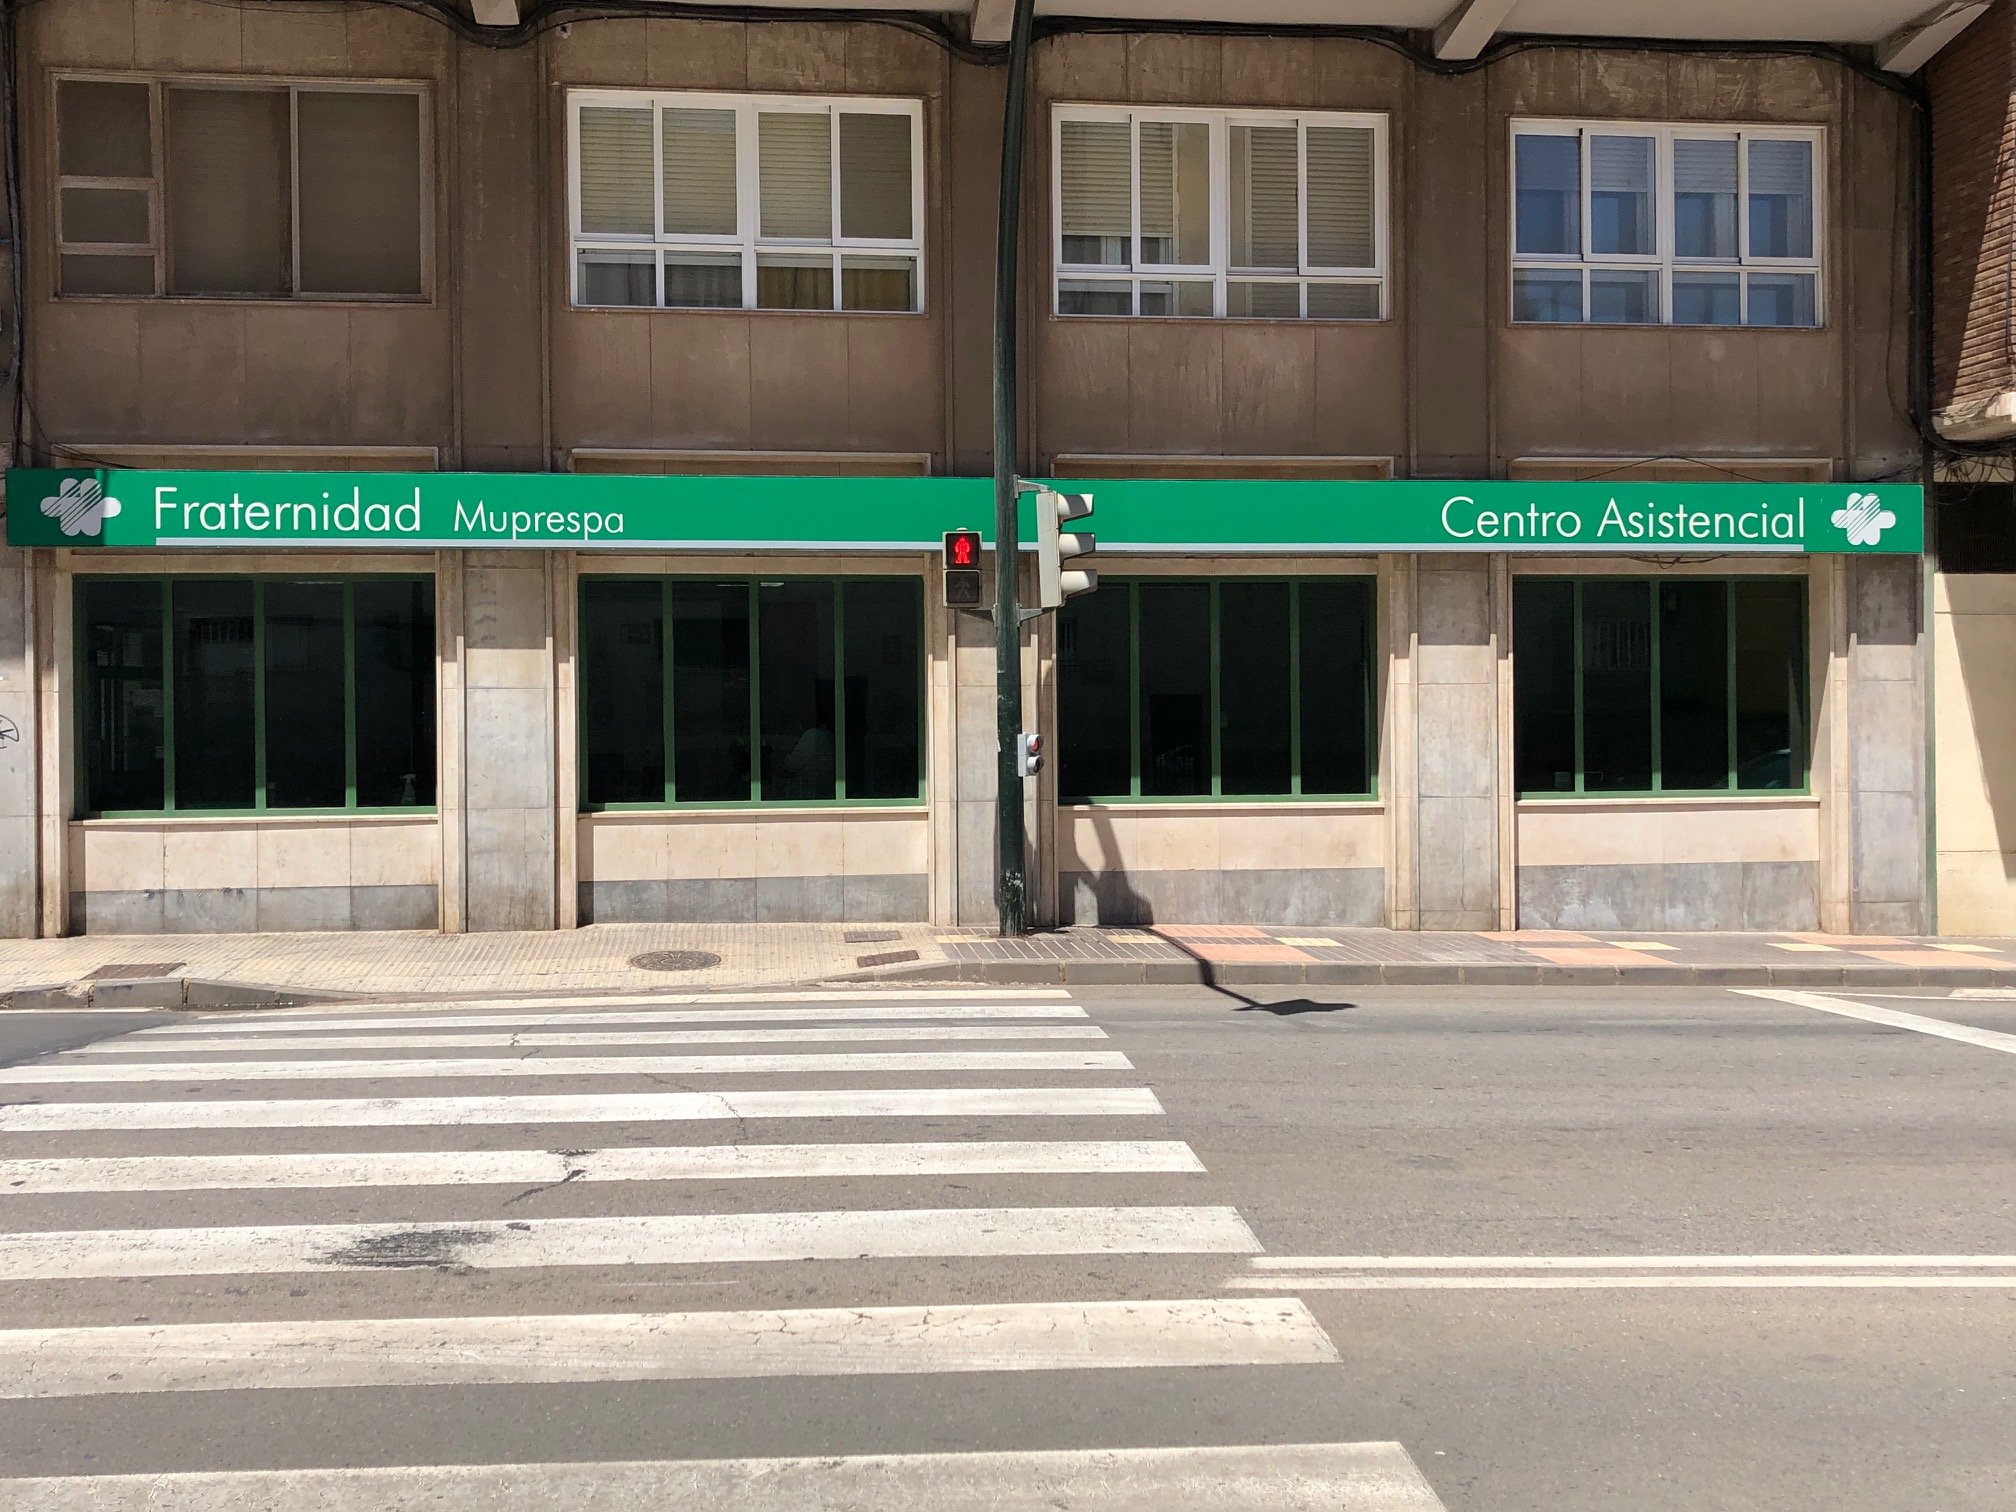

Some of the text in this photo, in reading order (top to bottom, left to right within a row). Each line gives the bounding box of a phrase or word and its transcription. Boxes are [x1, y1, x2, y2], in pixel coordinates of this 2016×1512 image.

[155, 486, 625, 540] Fraternidad Muprespa
[1441, 495, 1805, 539] Centro Asistencial
